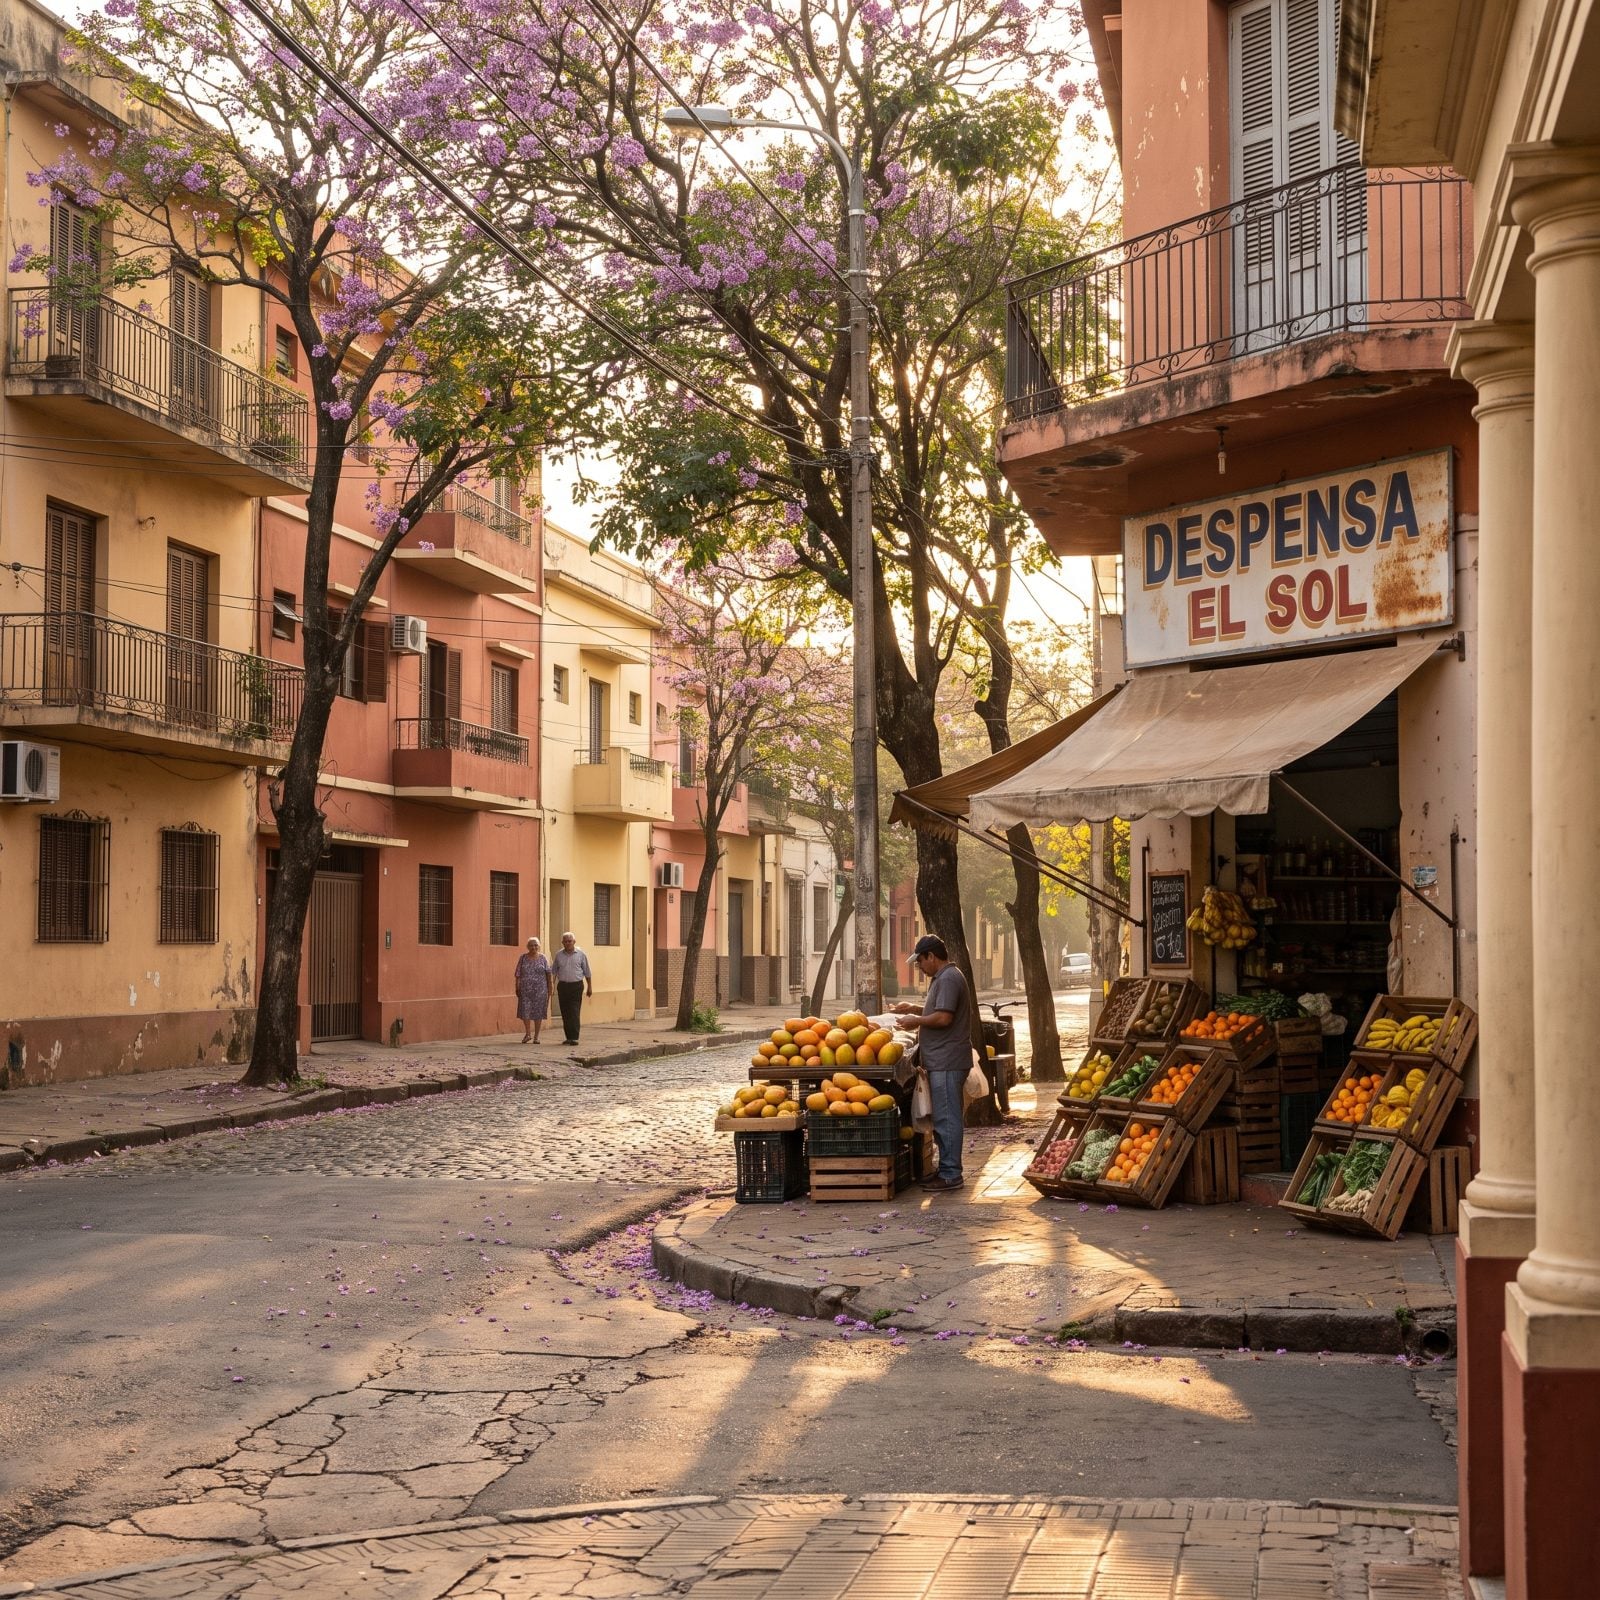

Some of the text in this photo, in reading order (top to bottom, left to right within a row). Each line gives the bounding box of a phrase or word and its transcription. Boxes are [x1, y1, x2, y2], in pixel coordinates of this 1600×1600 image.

[1143, 471, 1420, 591] DESPENSA
[1188, 564, 1368, 646] EL SOL
